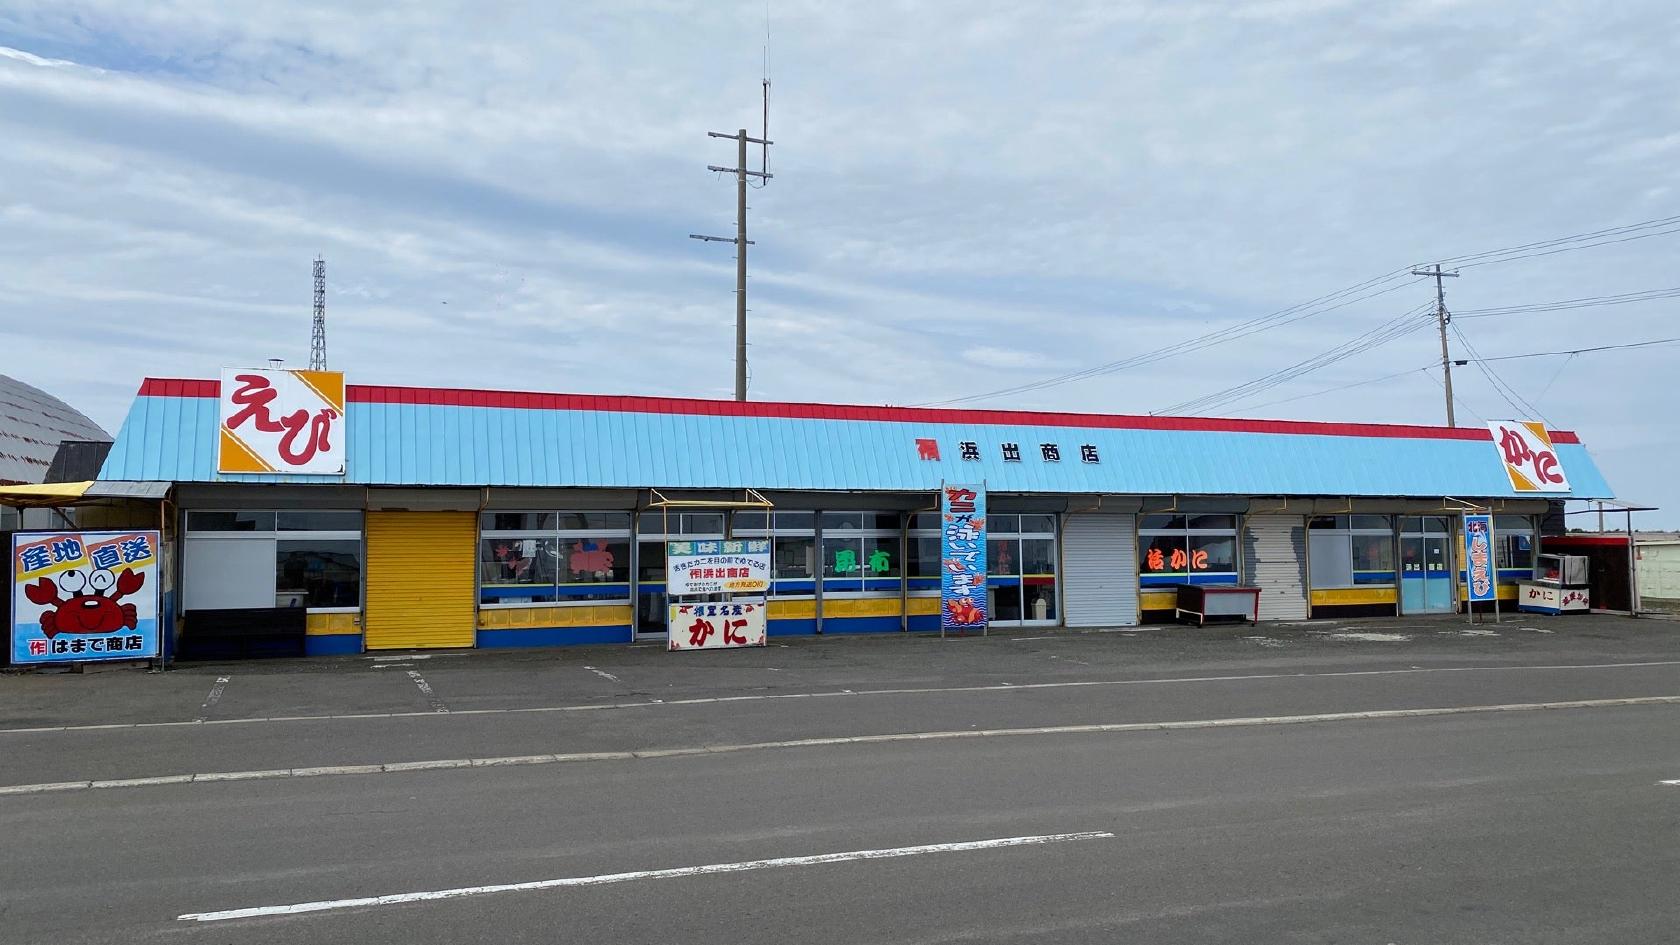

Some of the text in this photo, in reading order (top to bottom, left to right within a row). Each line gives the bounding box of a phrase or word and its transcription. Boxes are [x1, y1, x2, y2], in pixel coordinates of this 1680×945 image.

[226, 374, 337, 466] えび
[959, 440, 1100, 463] 浜出商店
[1500, 425, 1563, 484] かに
[19, 536, 152, 573] 産地 直送
[1147, 548, 1209, 571] 活かに
[703, 567, 750, 579] 浜出商店
[1529, 588, 1554, 601] かに
[693, 604, 743, 618] 根室名産
[688, 617, 749, 647] かに
[52, 635, 143, 654] はまで商店
